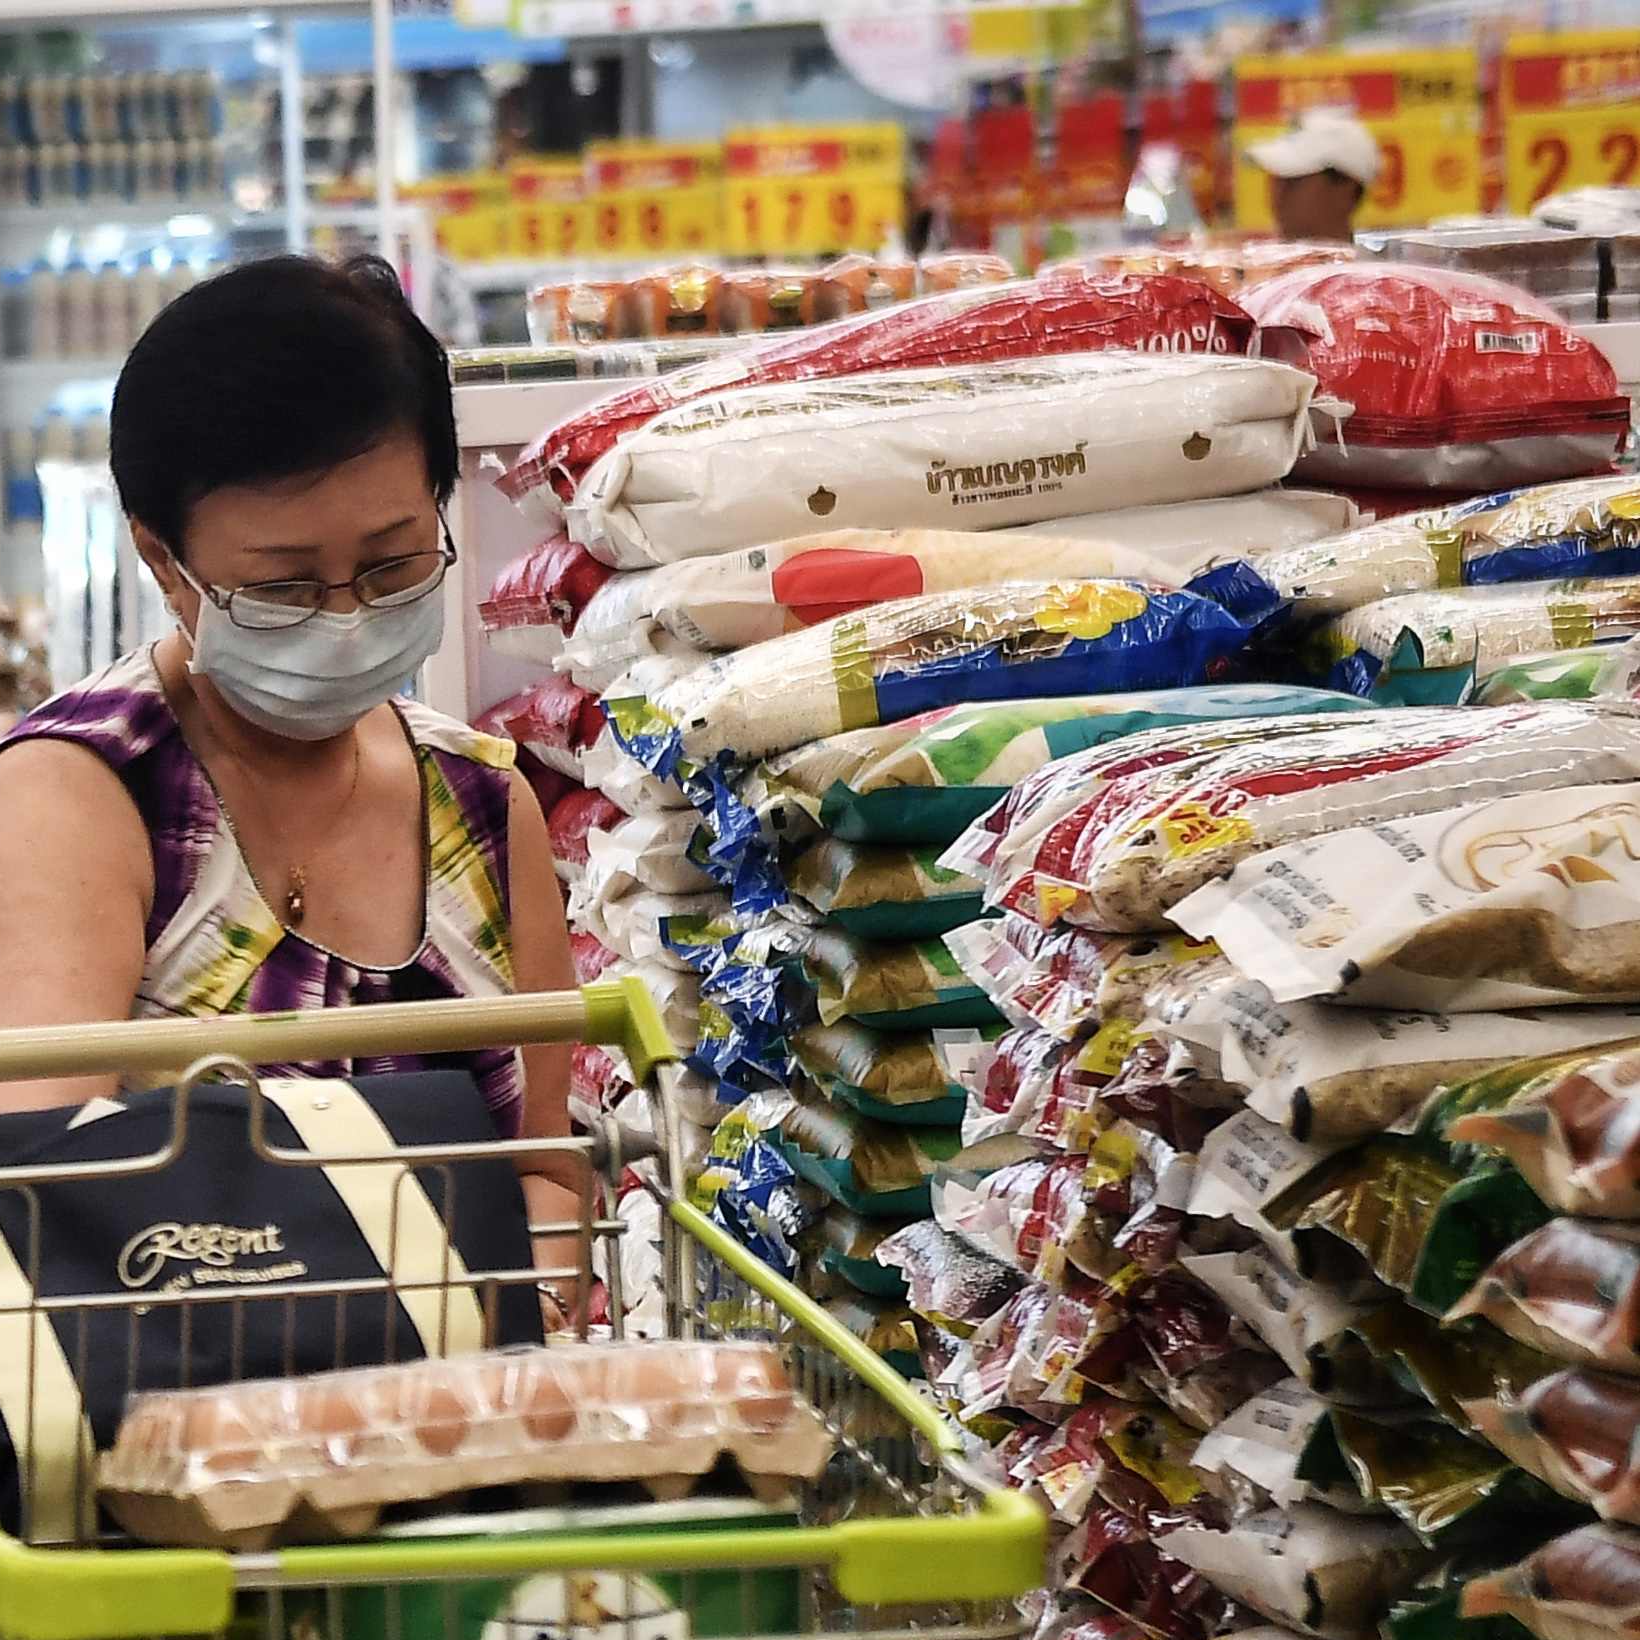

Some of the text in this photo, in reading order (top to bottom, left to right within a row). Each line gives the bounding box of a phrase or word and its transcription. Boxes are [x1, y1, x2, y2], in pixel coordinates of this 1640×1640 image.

[1135, 318, 1228, 355] 100%
[926, 440, 1089, 495] ข้าวเบญจรงค์
[117, 1221, 287, 1289] Regent
